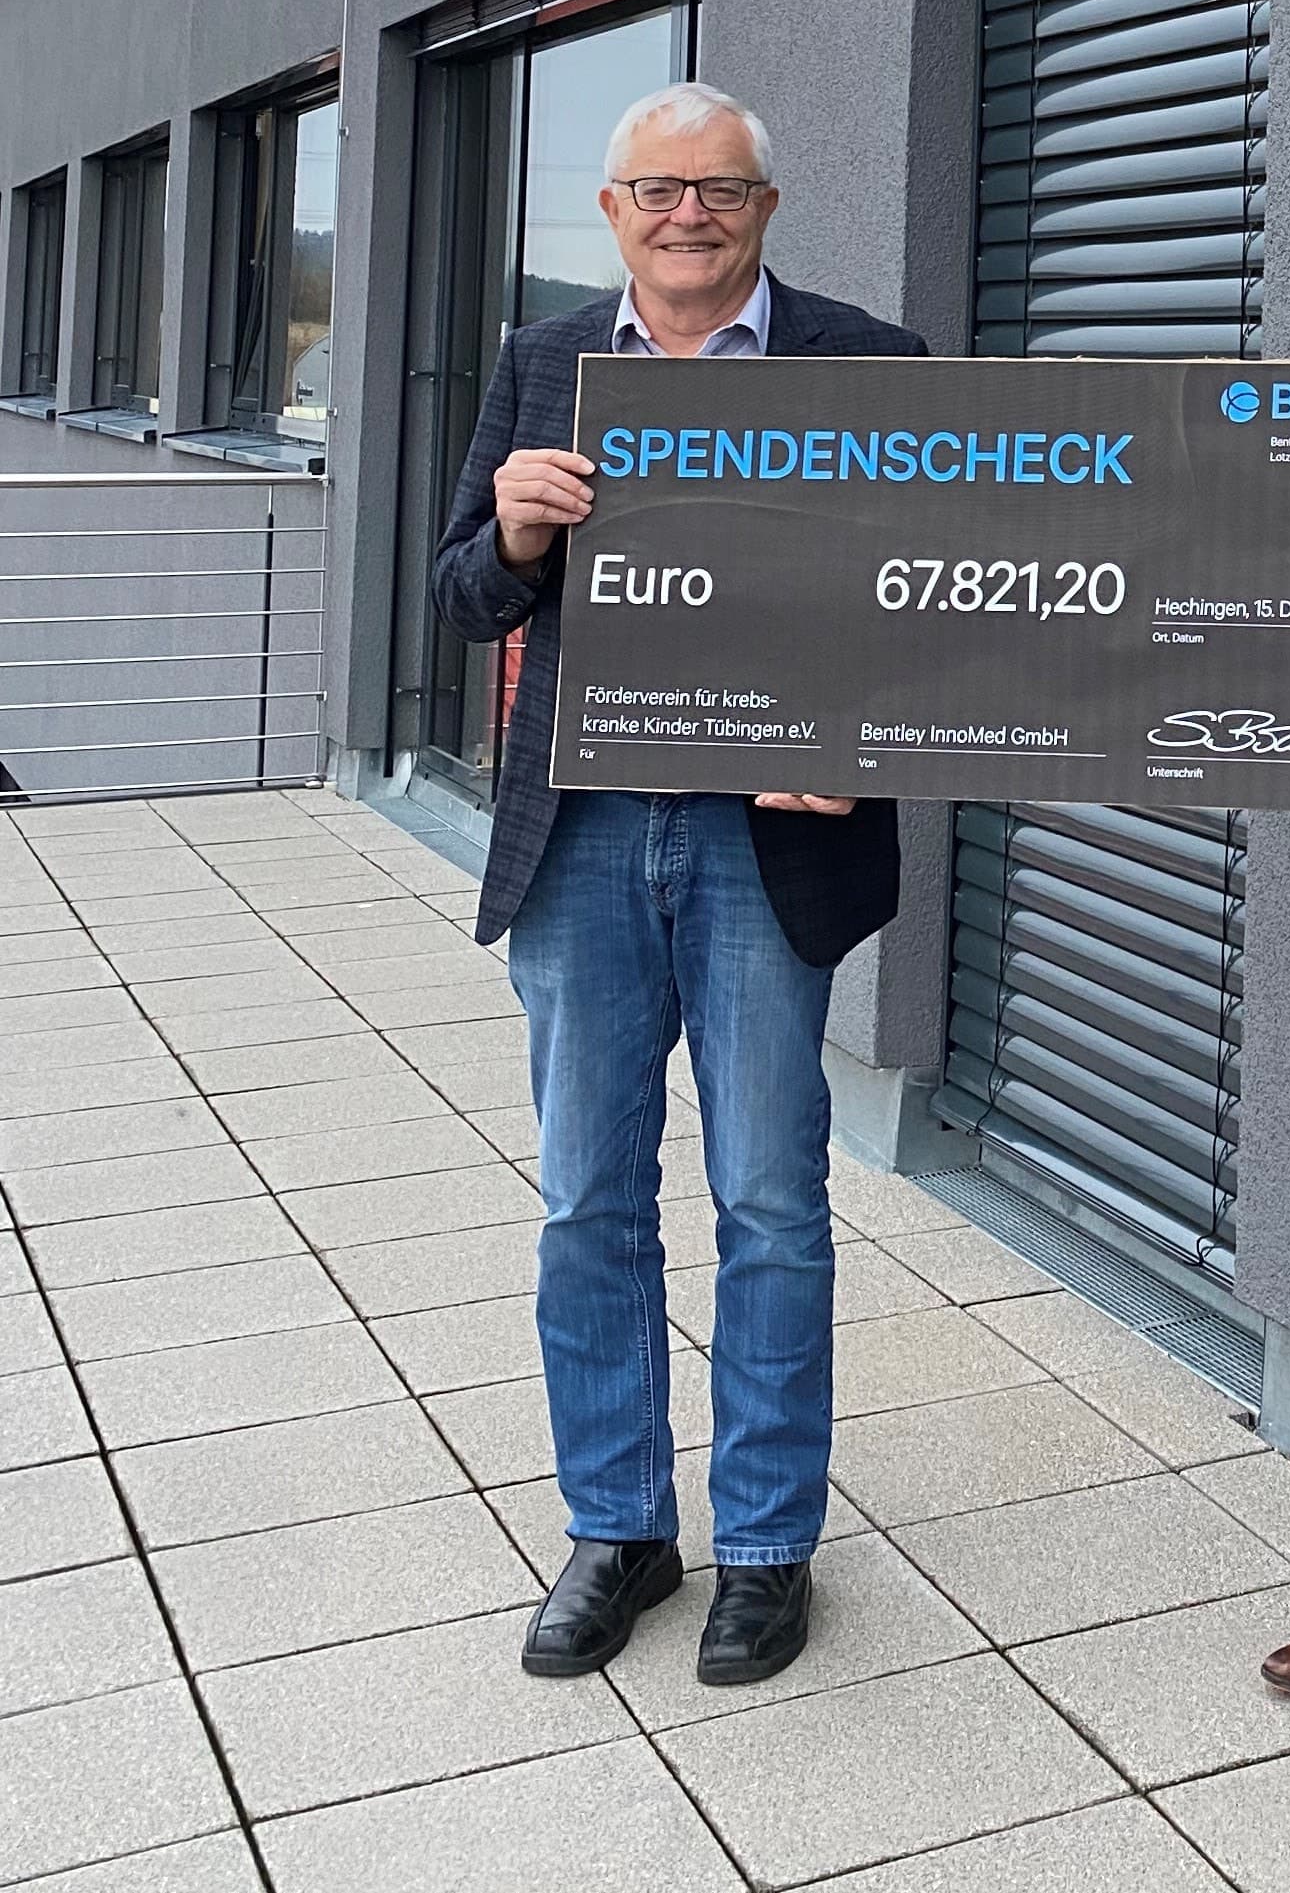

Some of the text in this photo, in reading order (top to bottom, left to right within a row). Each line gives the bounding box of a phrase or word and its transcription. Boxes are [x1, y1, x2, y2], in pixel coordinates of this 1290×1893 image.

[599, 427, 1134, 486] SPENDENSCHECK
[589, 554, 1126, 620] Euro 67.821,20
[1155, 598, 1249, 620] Hechingen,
[1253, 600, 1274, 618] 15.
[1172, 633, 1204, 644] Datum
[584, 686, 777, 708] Förderverein für krebs-
[582, 715, 816, 741] kranke Kinder Tübingen e.V.
[860, 722, 1069, 746] Bentley InnoMed GmbH
[579, 748, 595, 759] Für
[858, 758, 877, 768] Von
[1147, 766, 1204, 779] Unterschrift
